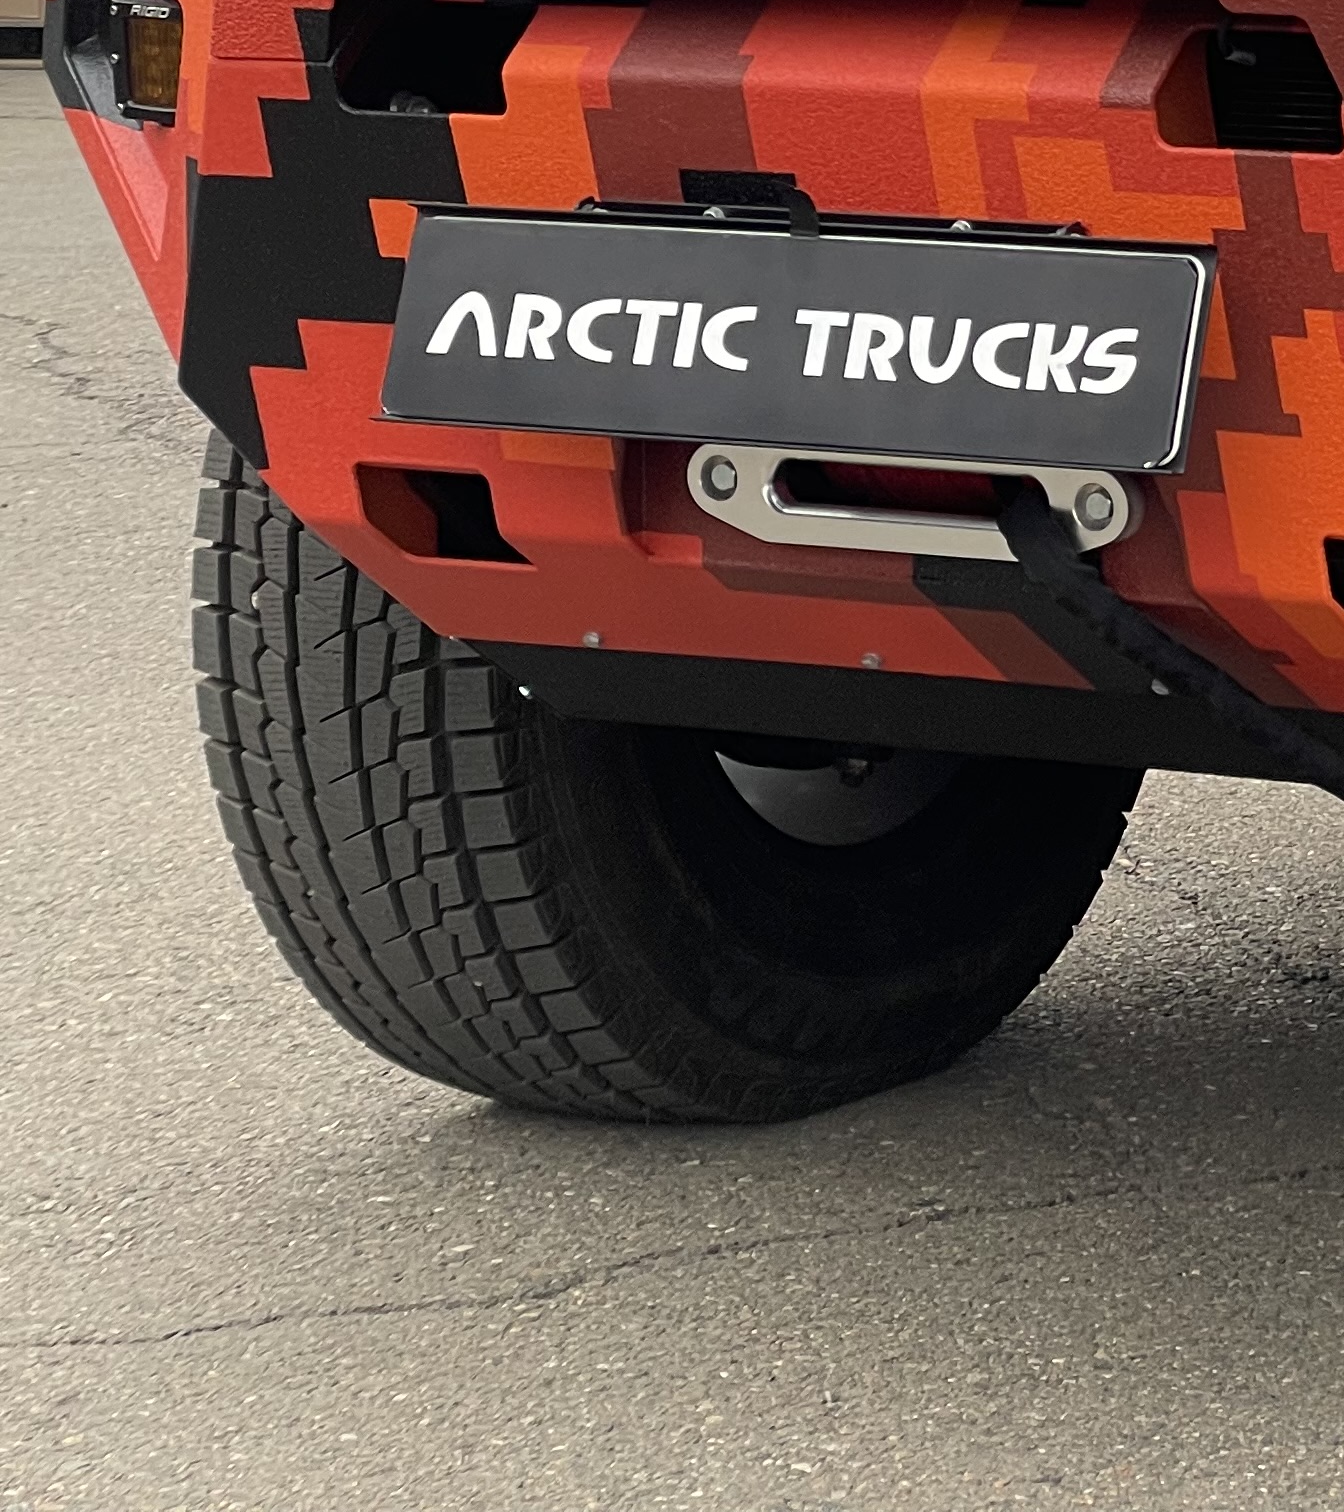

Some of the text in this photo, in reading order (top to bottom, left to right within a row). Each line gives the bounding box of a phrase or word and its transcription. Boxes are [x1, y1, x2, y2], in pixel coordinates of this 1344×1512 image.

[129, 4, 171, 19] RIGID
[425, 290, 1140, 394] ARCTIC TRUCKS
